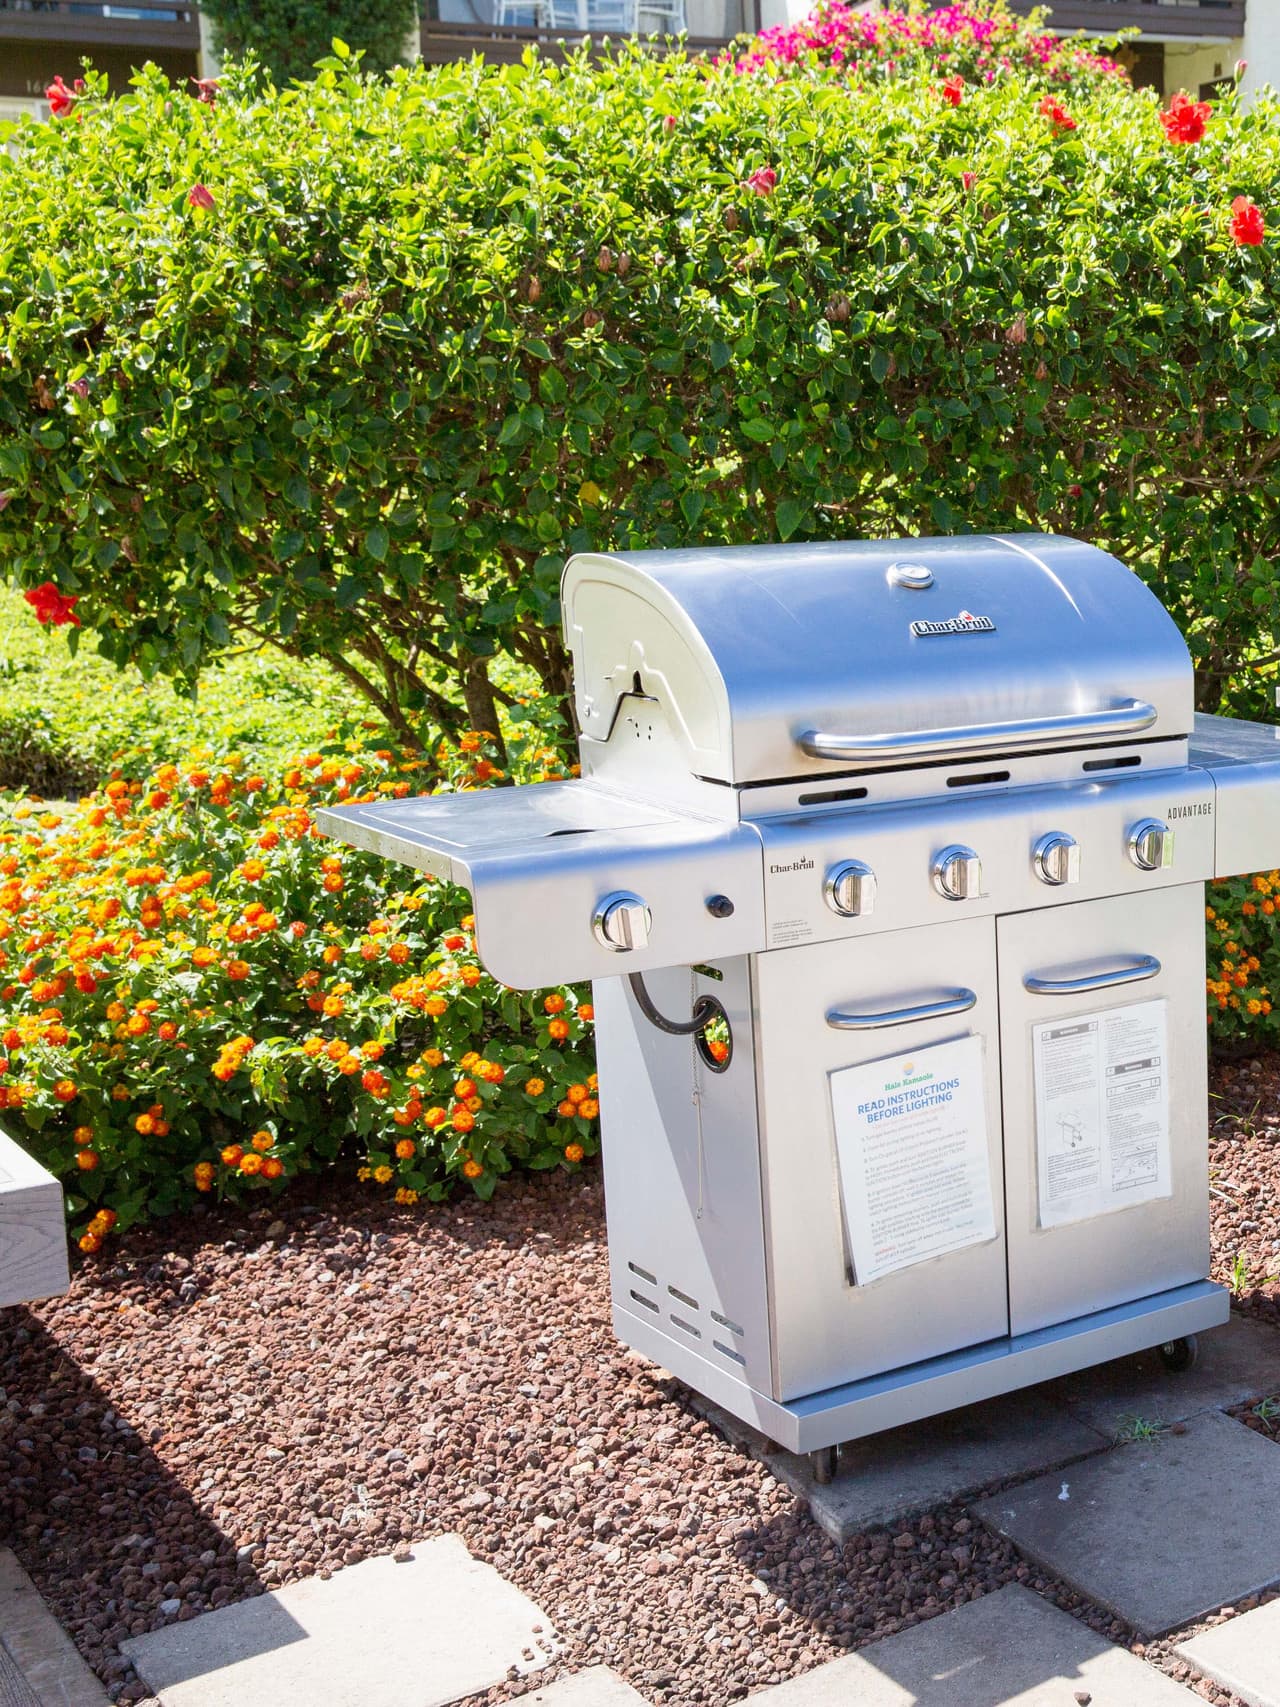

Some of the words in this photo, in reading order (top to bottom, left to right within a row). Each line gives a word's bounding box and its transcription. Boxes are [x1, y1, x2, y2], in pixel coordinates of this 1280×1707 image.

[912, 617, 994, 634] Char-Broil
[1167, 802, 1213, 820] ADVANTAGE
[770, 859, 815, 874] Char-Broil
[857, 1099, 886, 1115] READ
[887, 1078, 960, 1106] INSTRUCTIONS
[866, 1105, 905, 1124] BEFORE
[905, 1091, 953, 1112] LIGHTING
